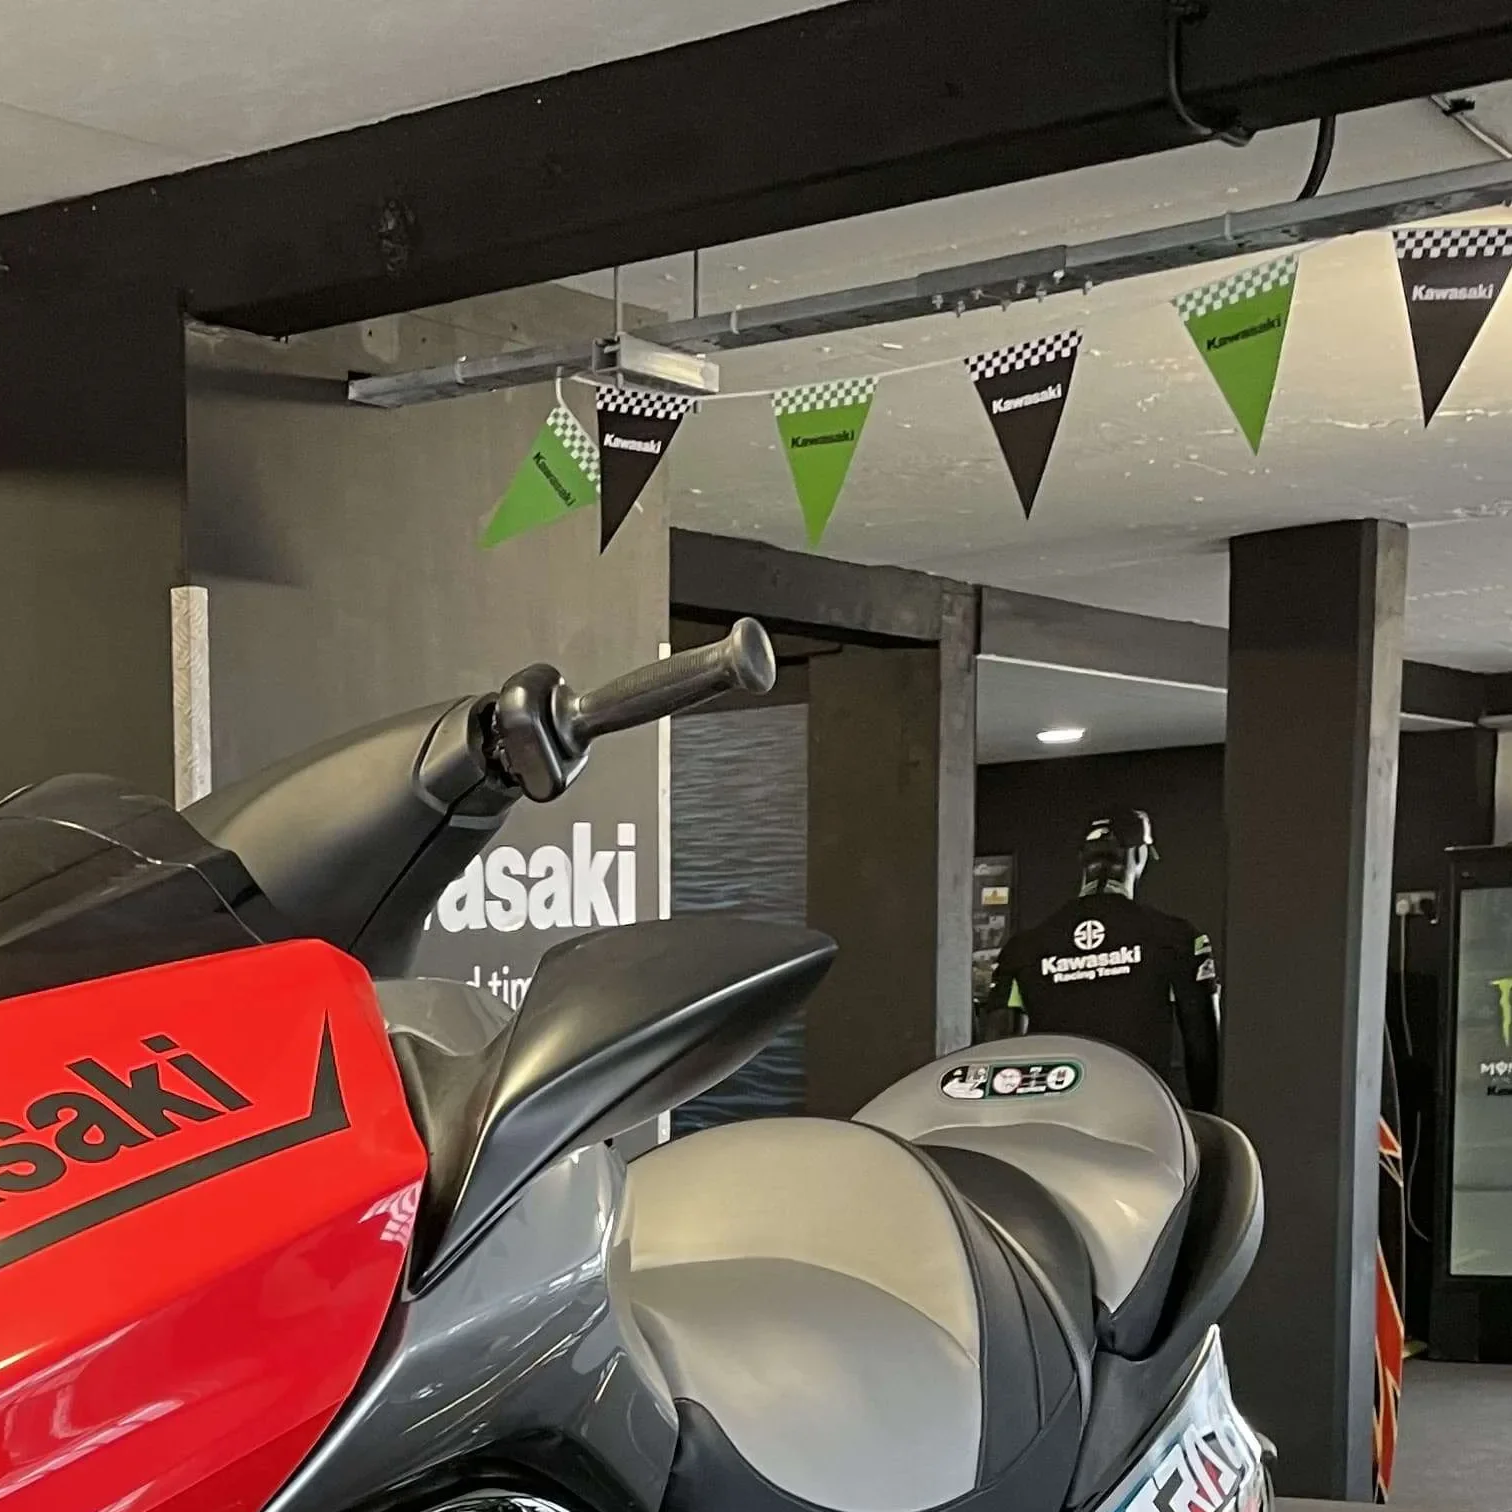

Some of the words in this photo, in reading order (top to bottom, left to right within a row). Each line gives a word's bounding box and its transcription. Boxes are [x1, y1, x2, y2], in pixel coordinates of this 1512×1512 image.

[1412, 284, 1494, 301] Kawasaki
[1206, 314, 1281, 350] Kawasaki
[992, 383, 1062, 415] Kawasaki
[604, 433, 662, 454] Kawasaki
[791, 430, 854, 449] Kawasaki
[533, 452, 576, 506] Kawasaki
[424, 822, 636, 932] asaki
[1041, 945, 1141, 975] Kawasaki
[1053, 969, 1096, 983] Racing
[1097, 965, 1130, 977] Team
